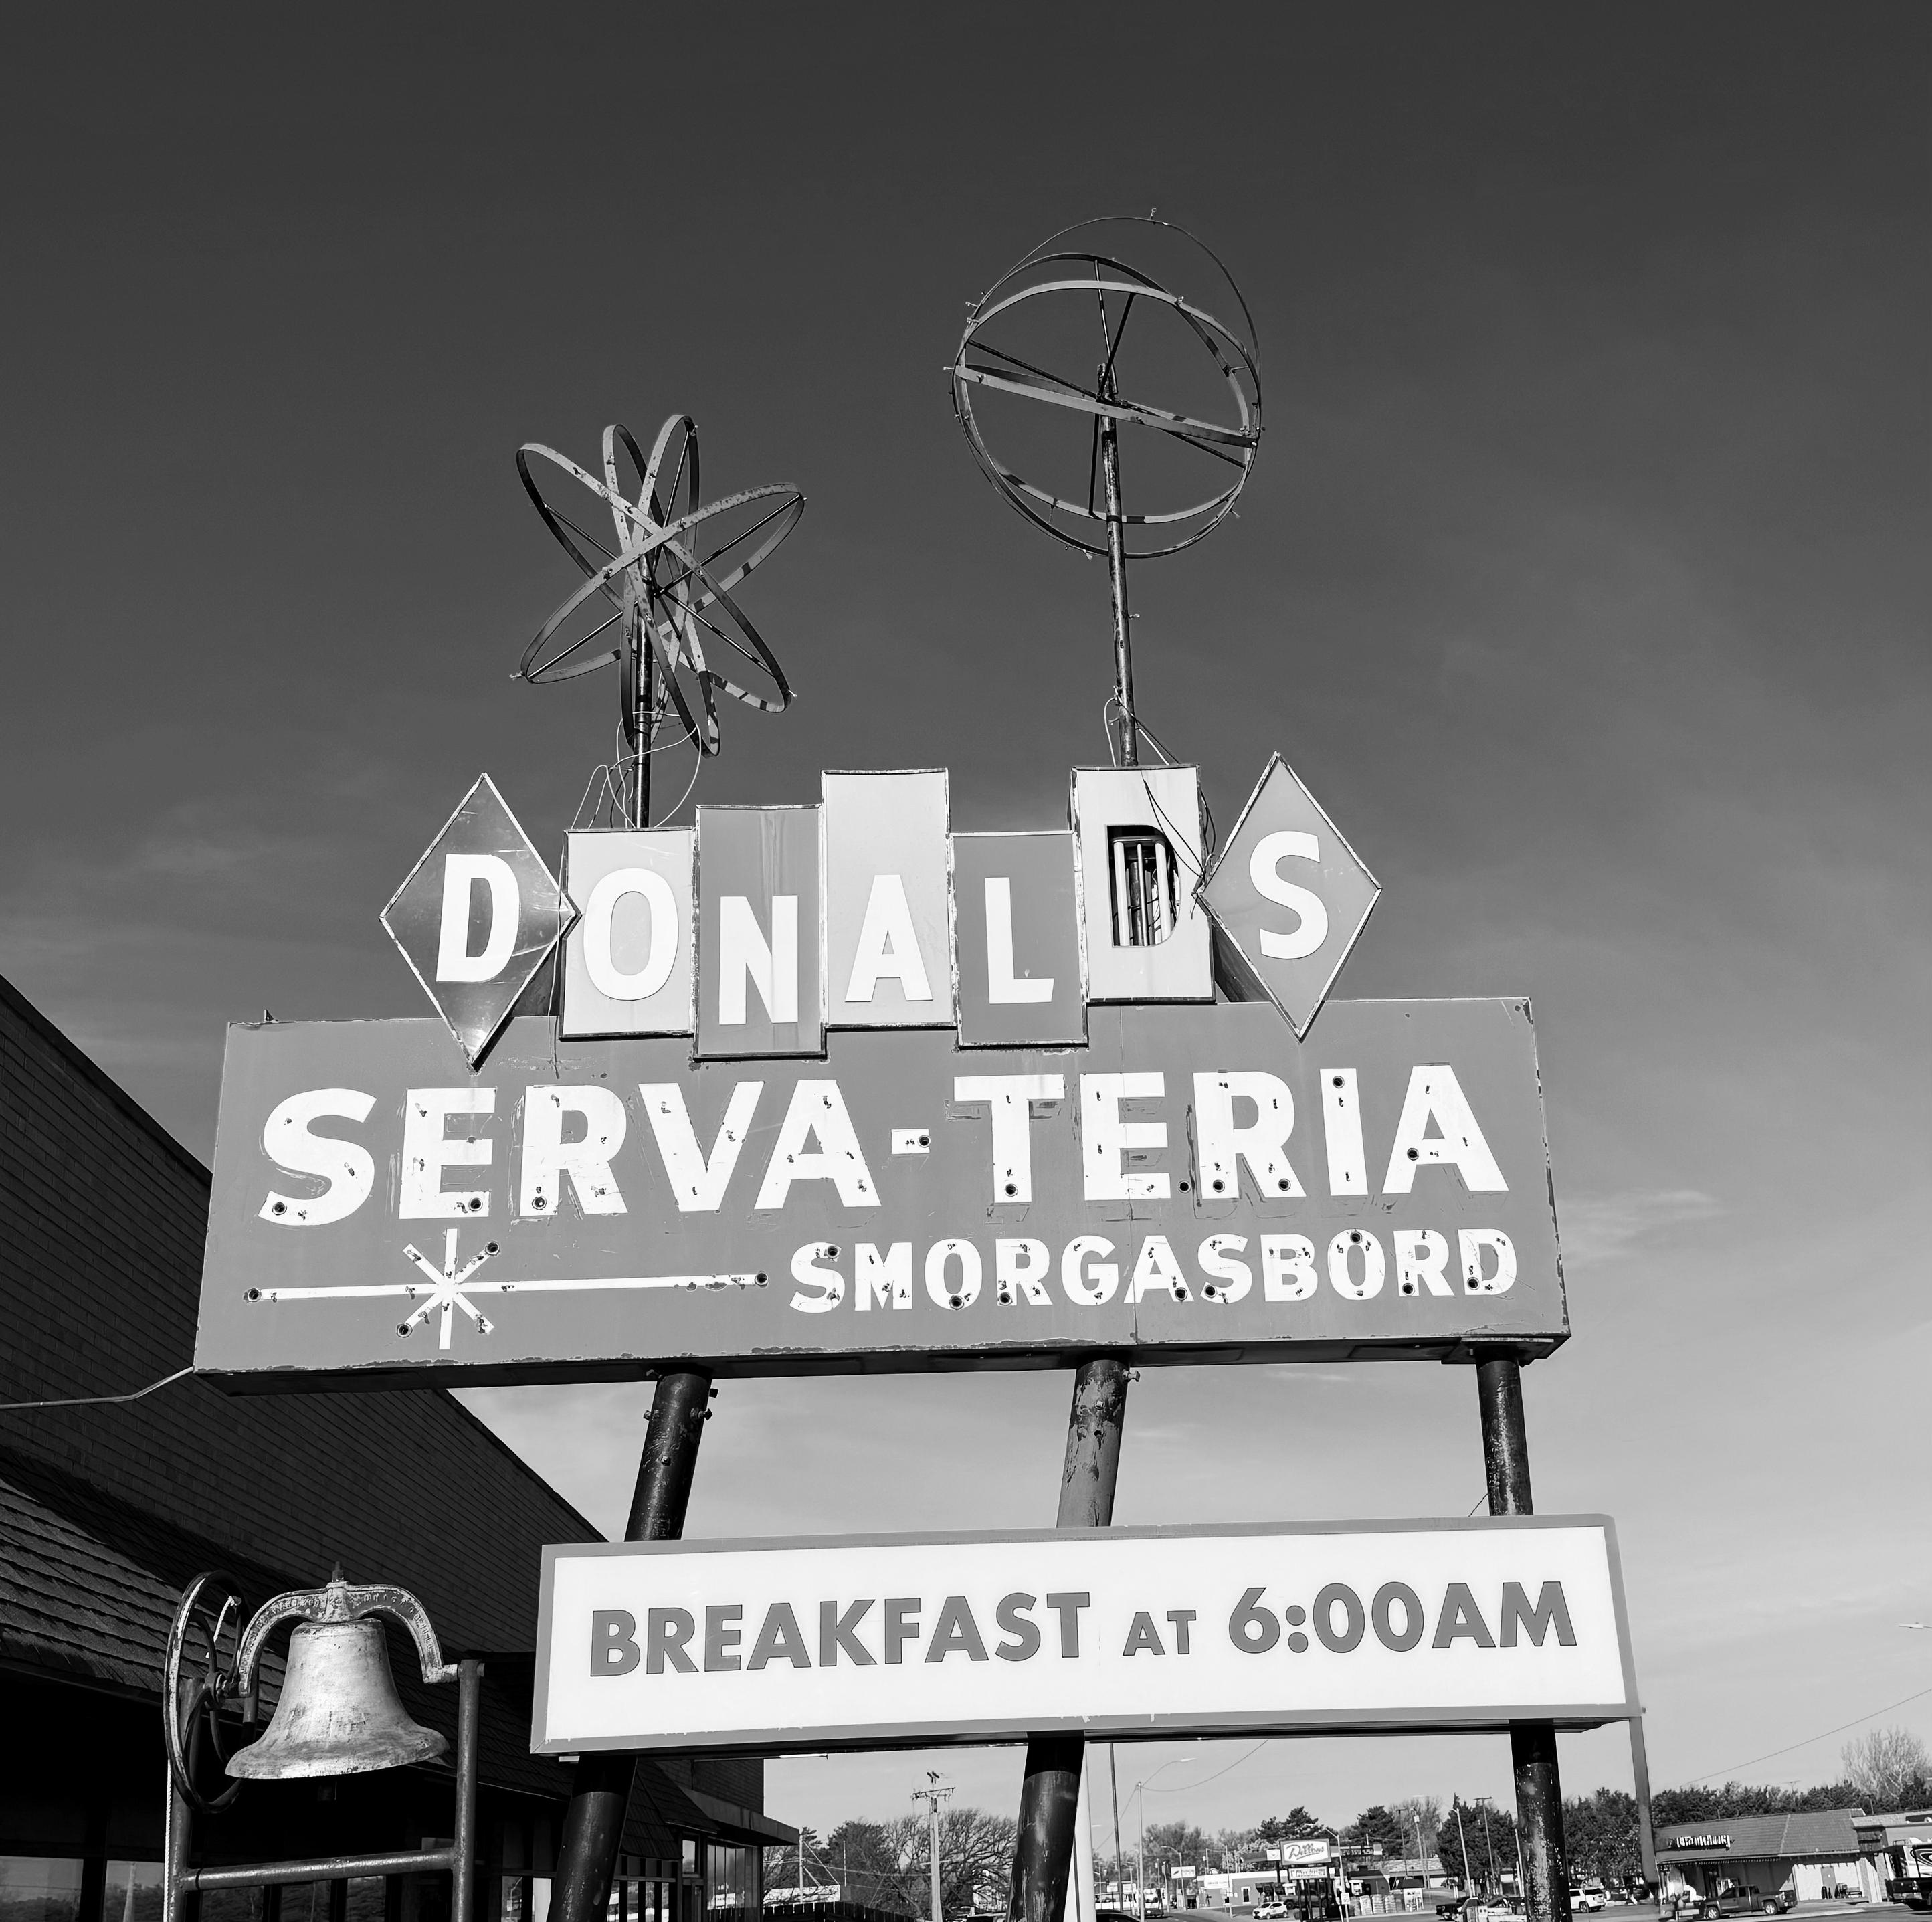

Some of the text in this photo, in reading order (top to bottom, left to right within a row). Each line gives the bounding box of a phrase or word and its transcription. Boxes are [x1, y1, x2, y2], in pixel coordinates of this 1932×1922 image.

[436, 825, 1328, 1025] DONALDS
[258, 1065, 1509, 1226] SERVA-TERIA
[789, 1228, 1517, 1313] SMORGASBORD
[589, 1581, 1578, 1678] BREAKFAST AT 6:00AM
